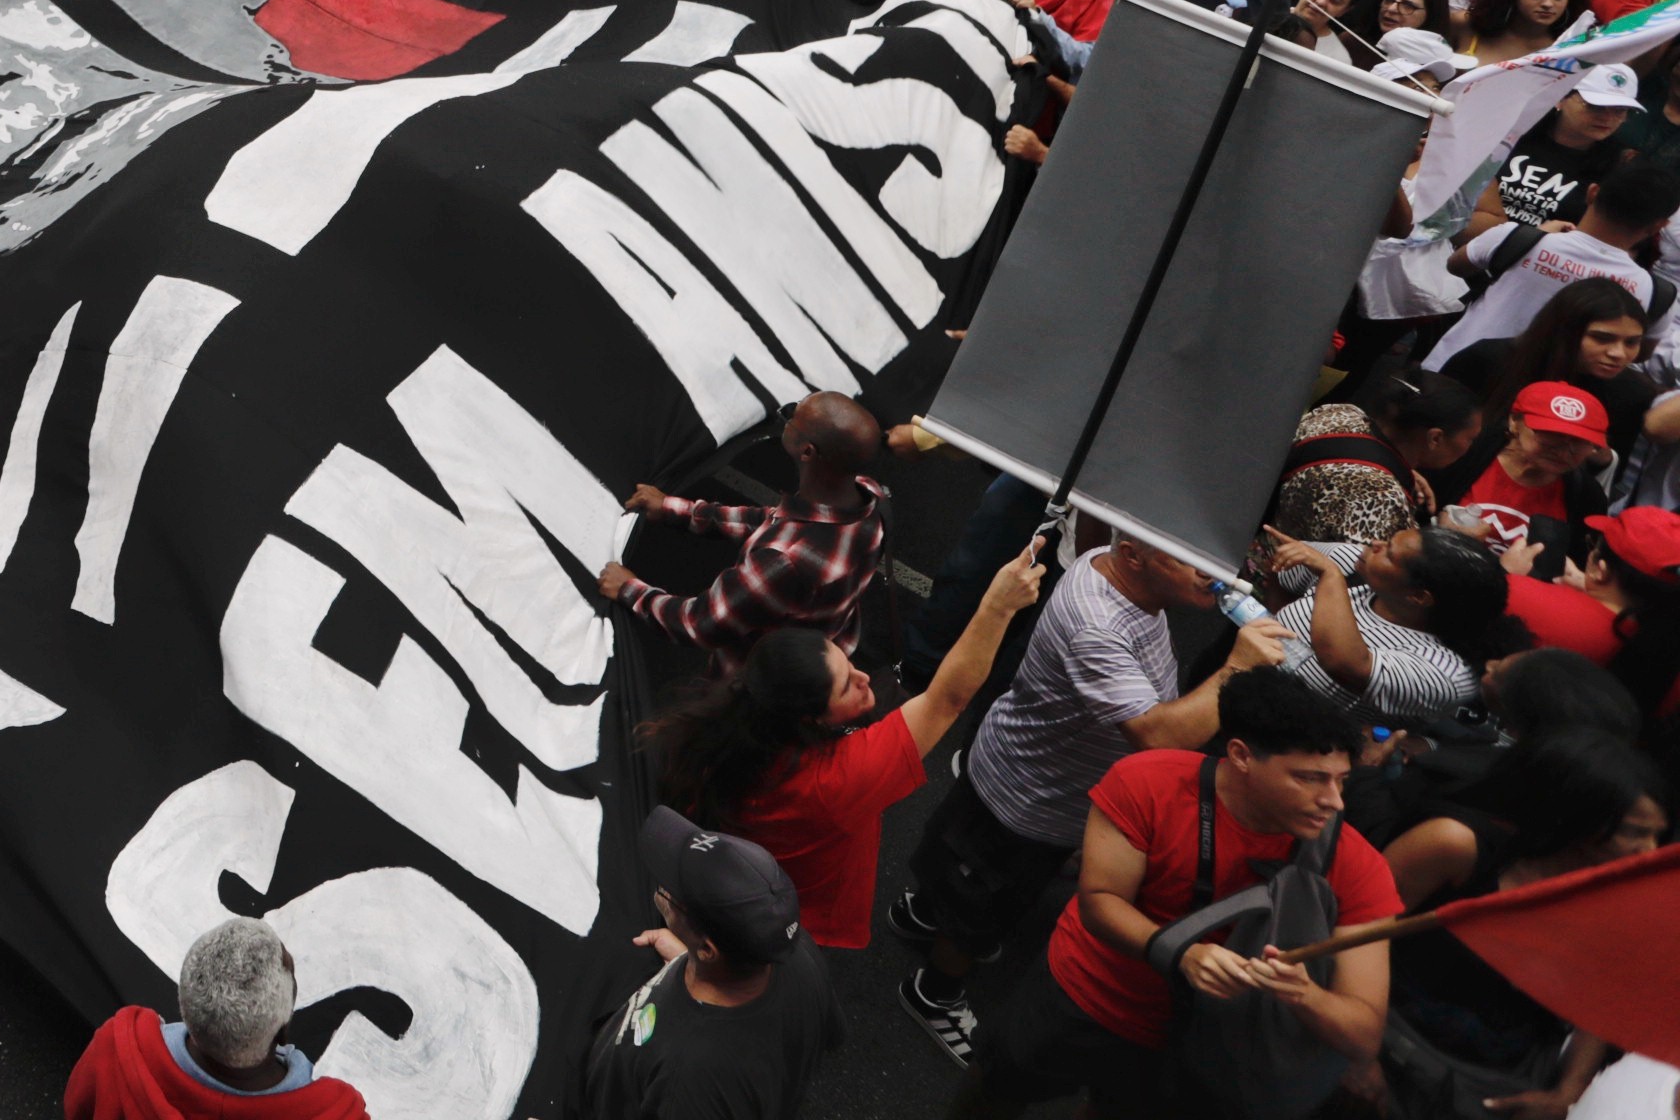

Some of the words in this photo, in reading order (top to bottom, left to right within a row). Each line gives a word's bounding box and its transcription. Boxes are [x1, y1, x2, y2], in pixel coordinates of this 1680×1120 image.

[1501, 155, 1578, 201] SEM
[1498, 182, 1560, 213] ANISTIA
[1533, 262, 1570, 284] TEMPO
